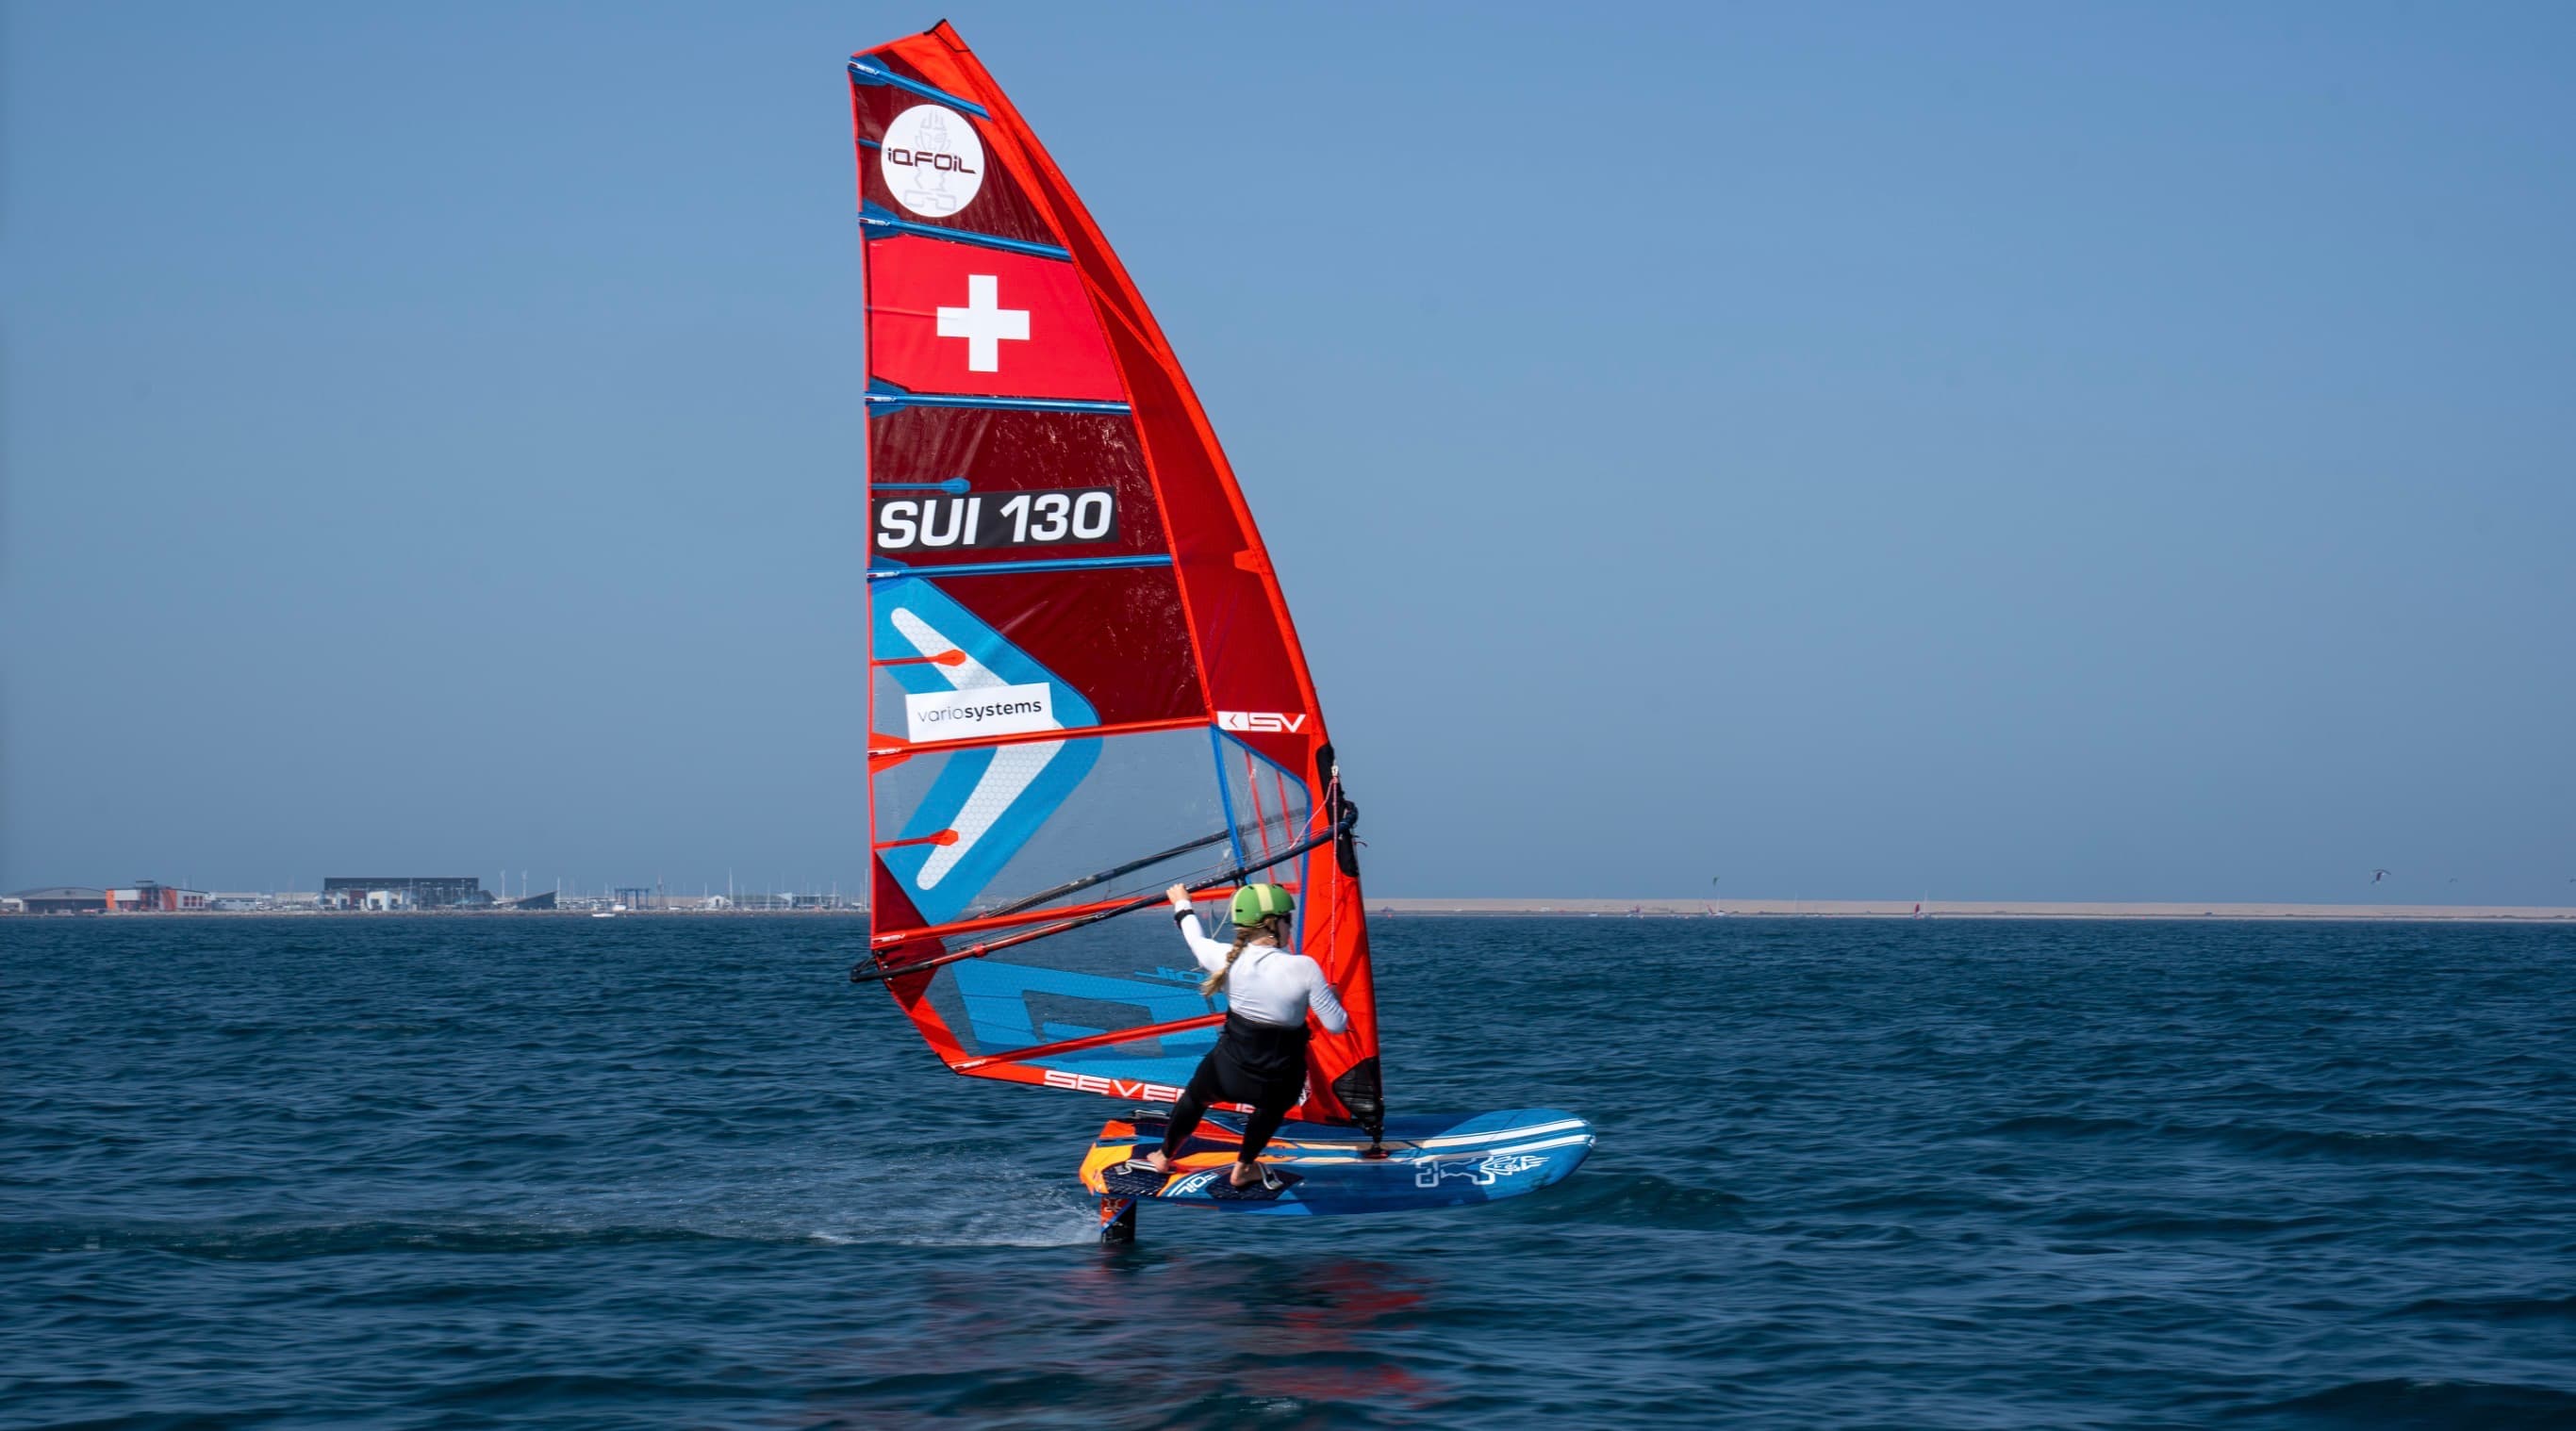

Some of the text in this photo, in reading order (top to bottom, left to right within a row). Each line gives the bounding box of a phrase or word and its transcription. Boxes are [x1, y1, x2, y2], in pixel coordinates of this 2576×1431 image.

[877, 491, 1113, 549] SUI 130
[917, 700, 1042, 722] variosystems
